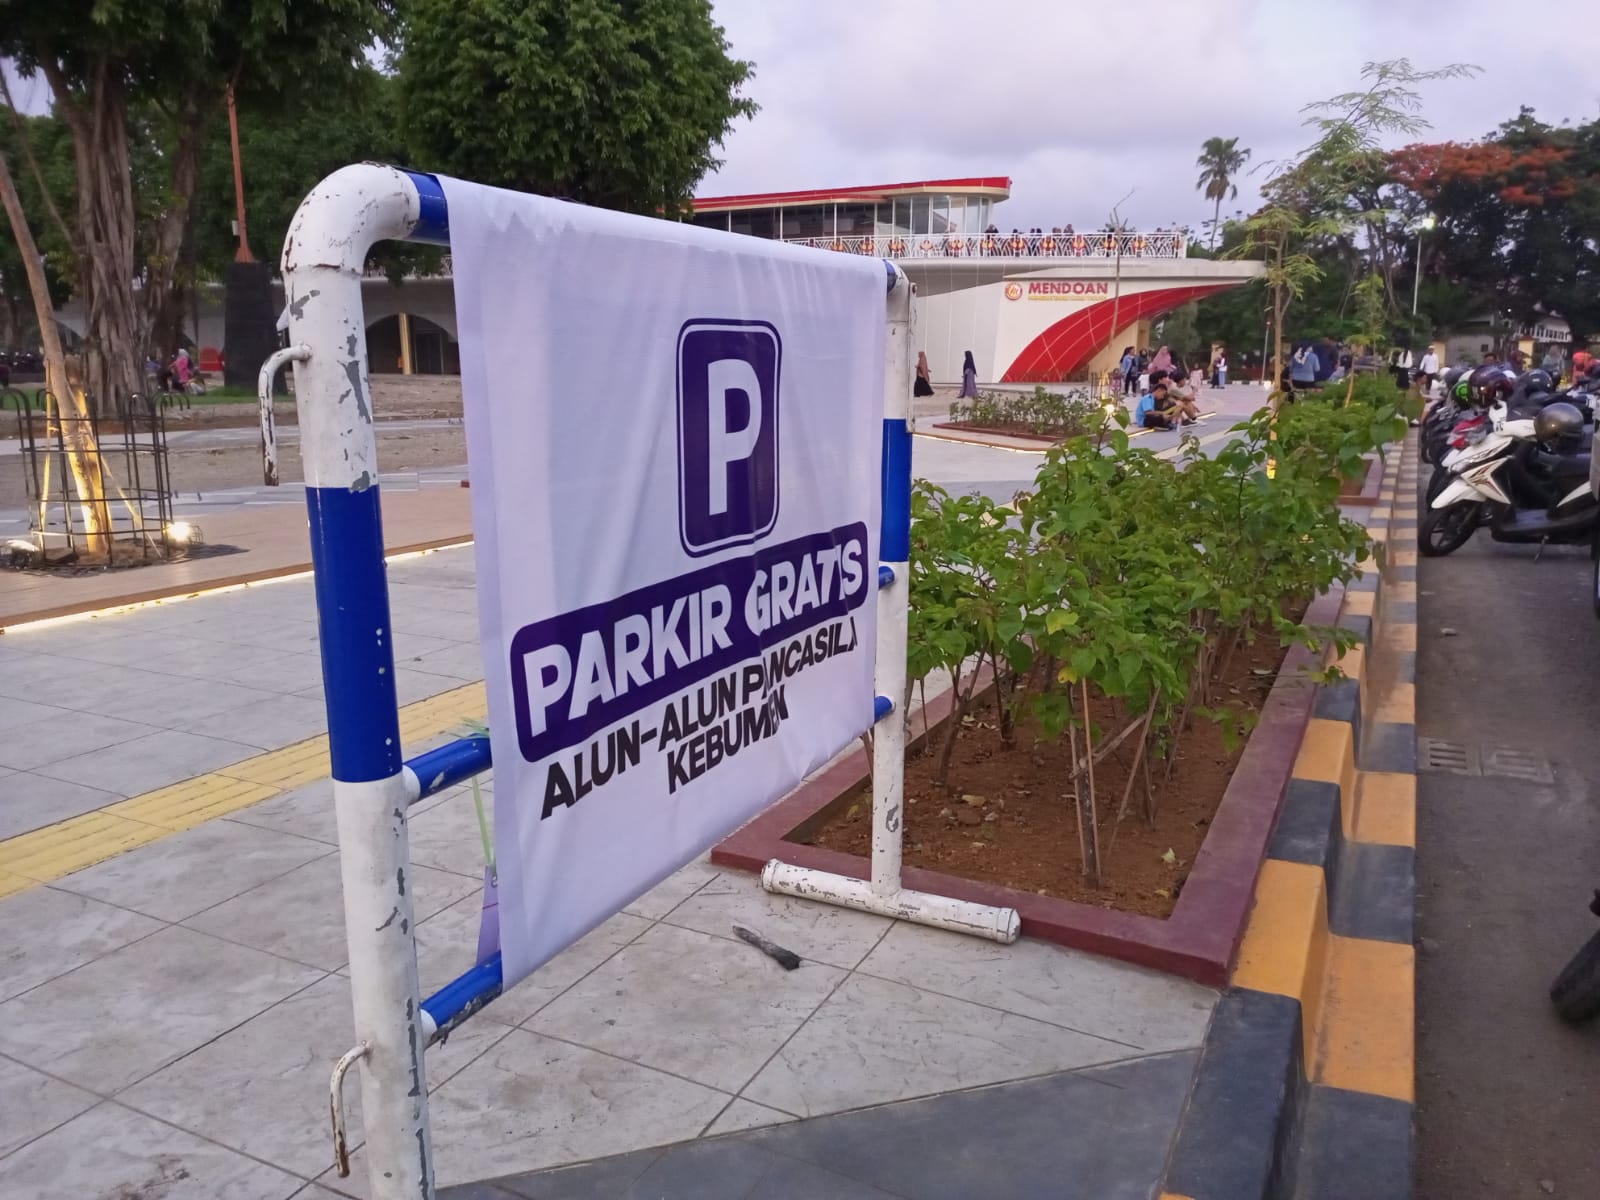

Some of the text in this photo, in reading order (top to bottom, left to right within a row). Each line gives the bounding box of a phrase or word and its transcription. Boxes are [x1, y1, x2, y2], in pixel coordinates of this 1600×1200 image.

[1028, 282, 1109, 295] MENDOAN
[707, 358, 763, 516] P
[523, 539, 863, 738] PARKIR GRATIS
[540, 671, 737, 821] ALUN-ALUN
[667, 683, 789, 795] KEBUMEN
